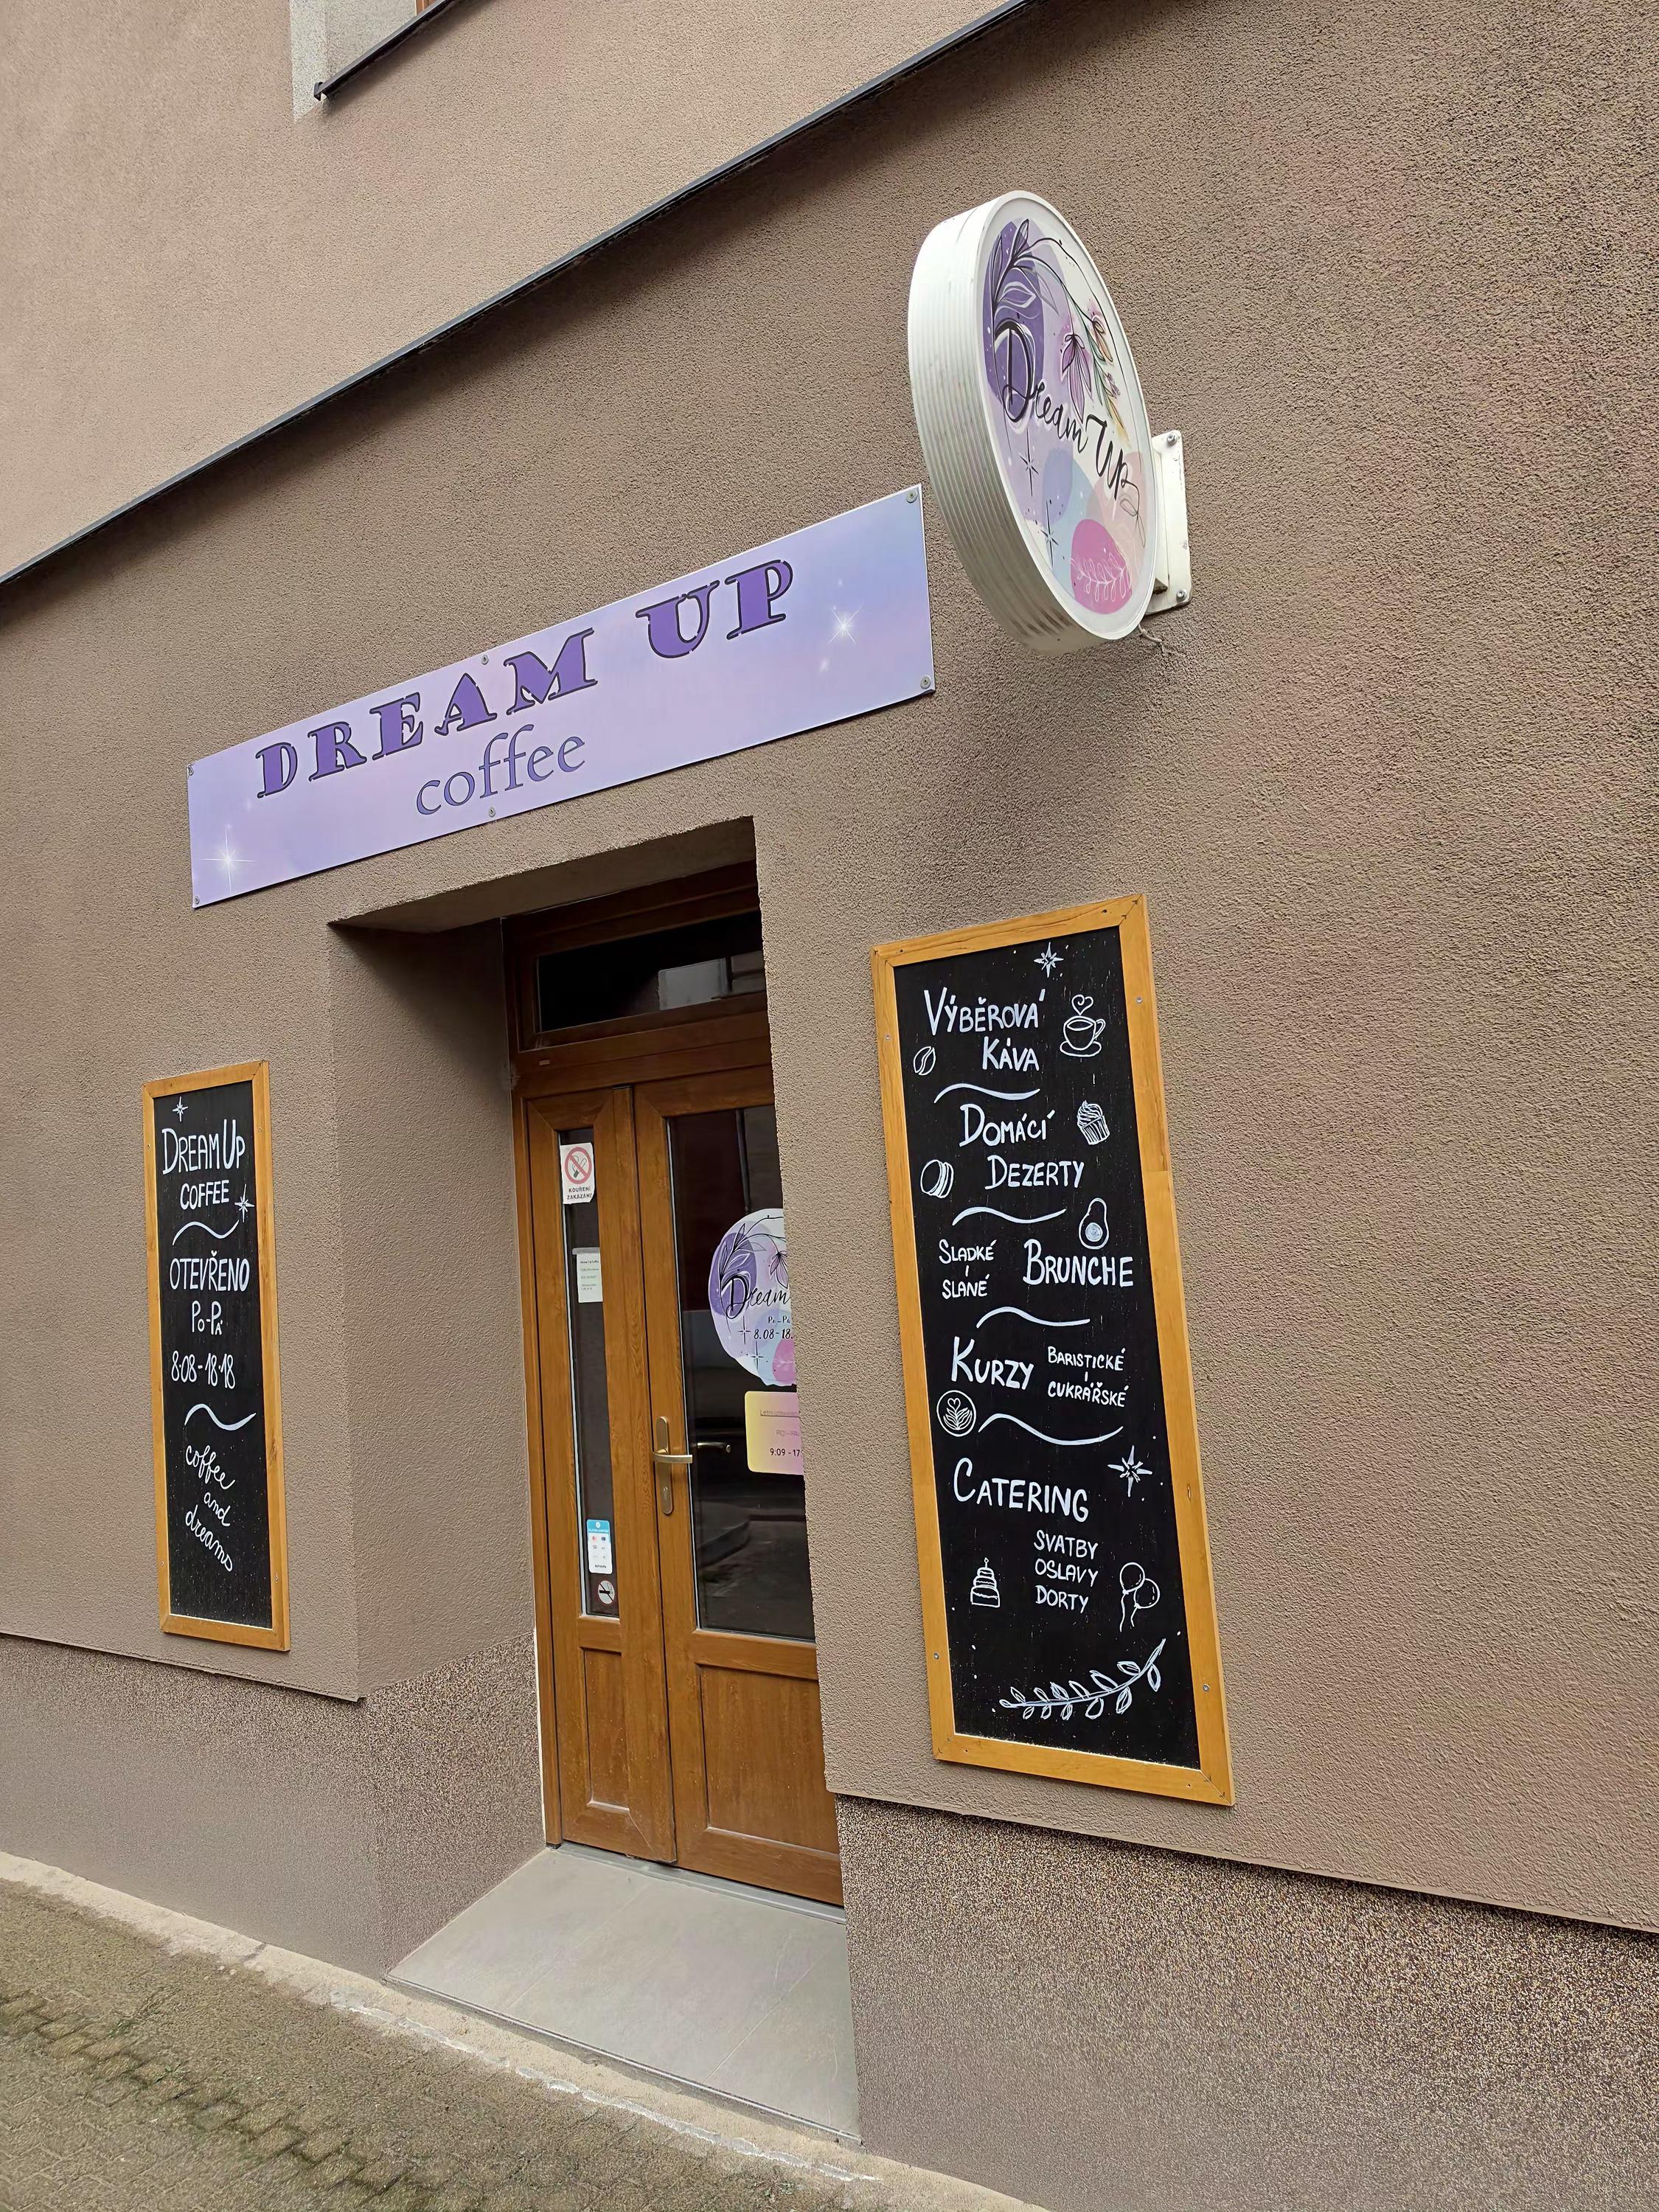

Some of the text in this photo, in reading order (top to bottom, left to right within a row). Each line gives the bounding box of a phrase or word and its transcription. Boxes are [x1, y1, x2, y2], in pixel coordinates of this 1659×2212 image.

[995, 317, 1092, 453] Dream
[255, 558, 794, 799] DREAM UP
[416, 723, 585, 815] coffee
[983, 1037, 1039, 1071] KÁVA
[985, 1155, 1084, 1189] DEZERTY
[181, 1180, 229, 1209] COFFEE
[170, 1251, 249, 1291] OTEVŘENO
[1023, 1239, 1133, 1287] BRUNCHE
[942, 1274, 990, 1299] SLANÉ
[952, 1337, 1034, 1390] KURZY
[186, 1445, 235, 1489] coffee
[204, 1492, 230, 1526] and
[954, 1458, 1088, 1522] CATERING
[186, 1505, 232, 1571] dreams
[1034, 1530, 1098, 1559] SVATBY
[1035, 1559, 1098, 1587] OSLAVY
[1036, 1585, 1088, 1613] DORTY
